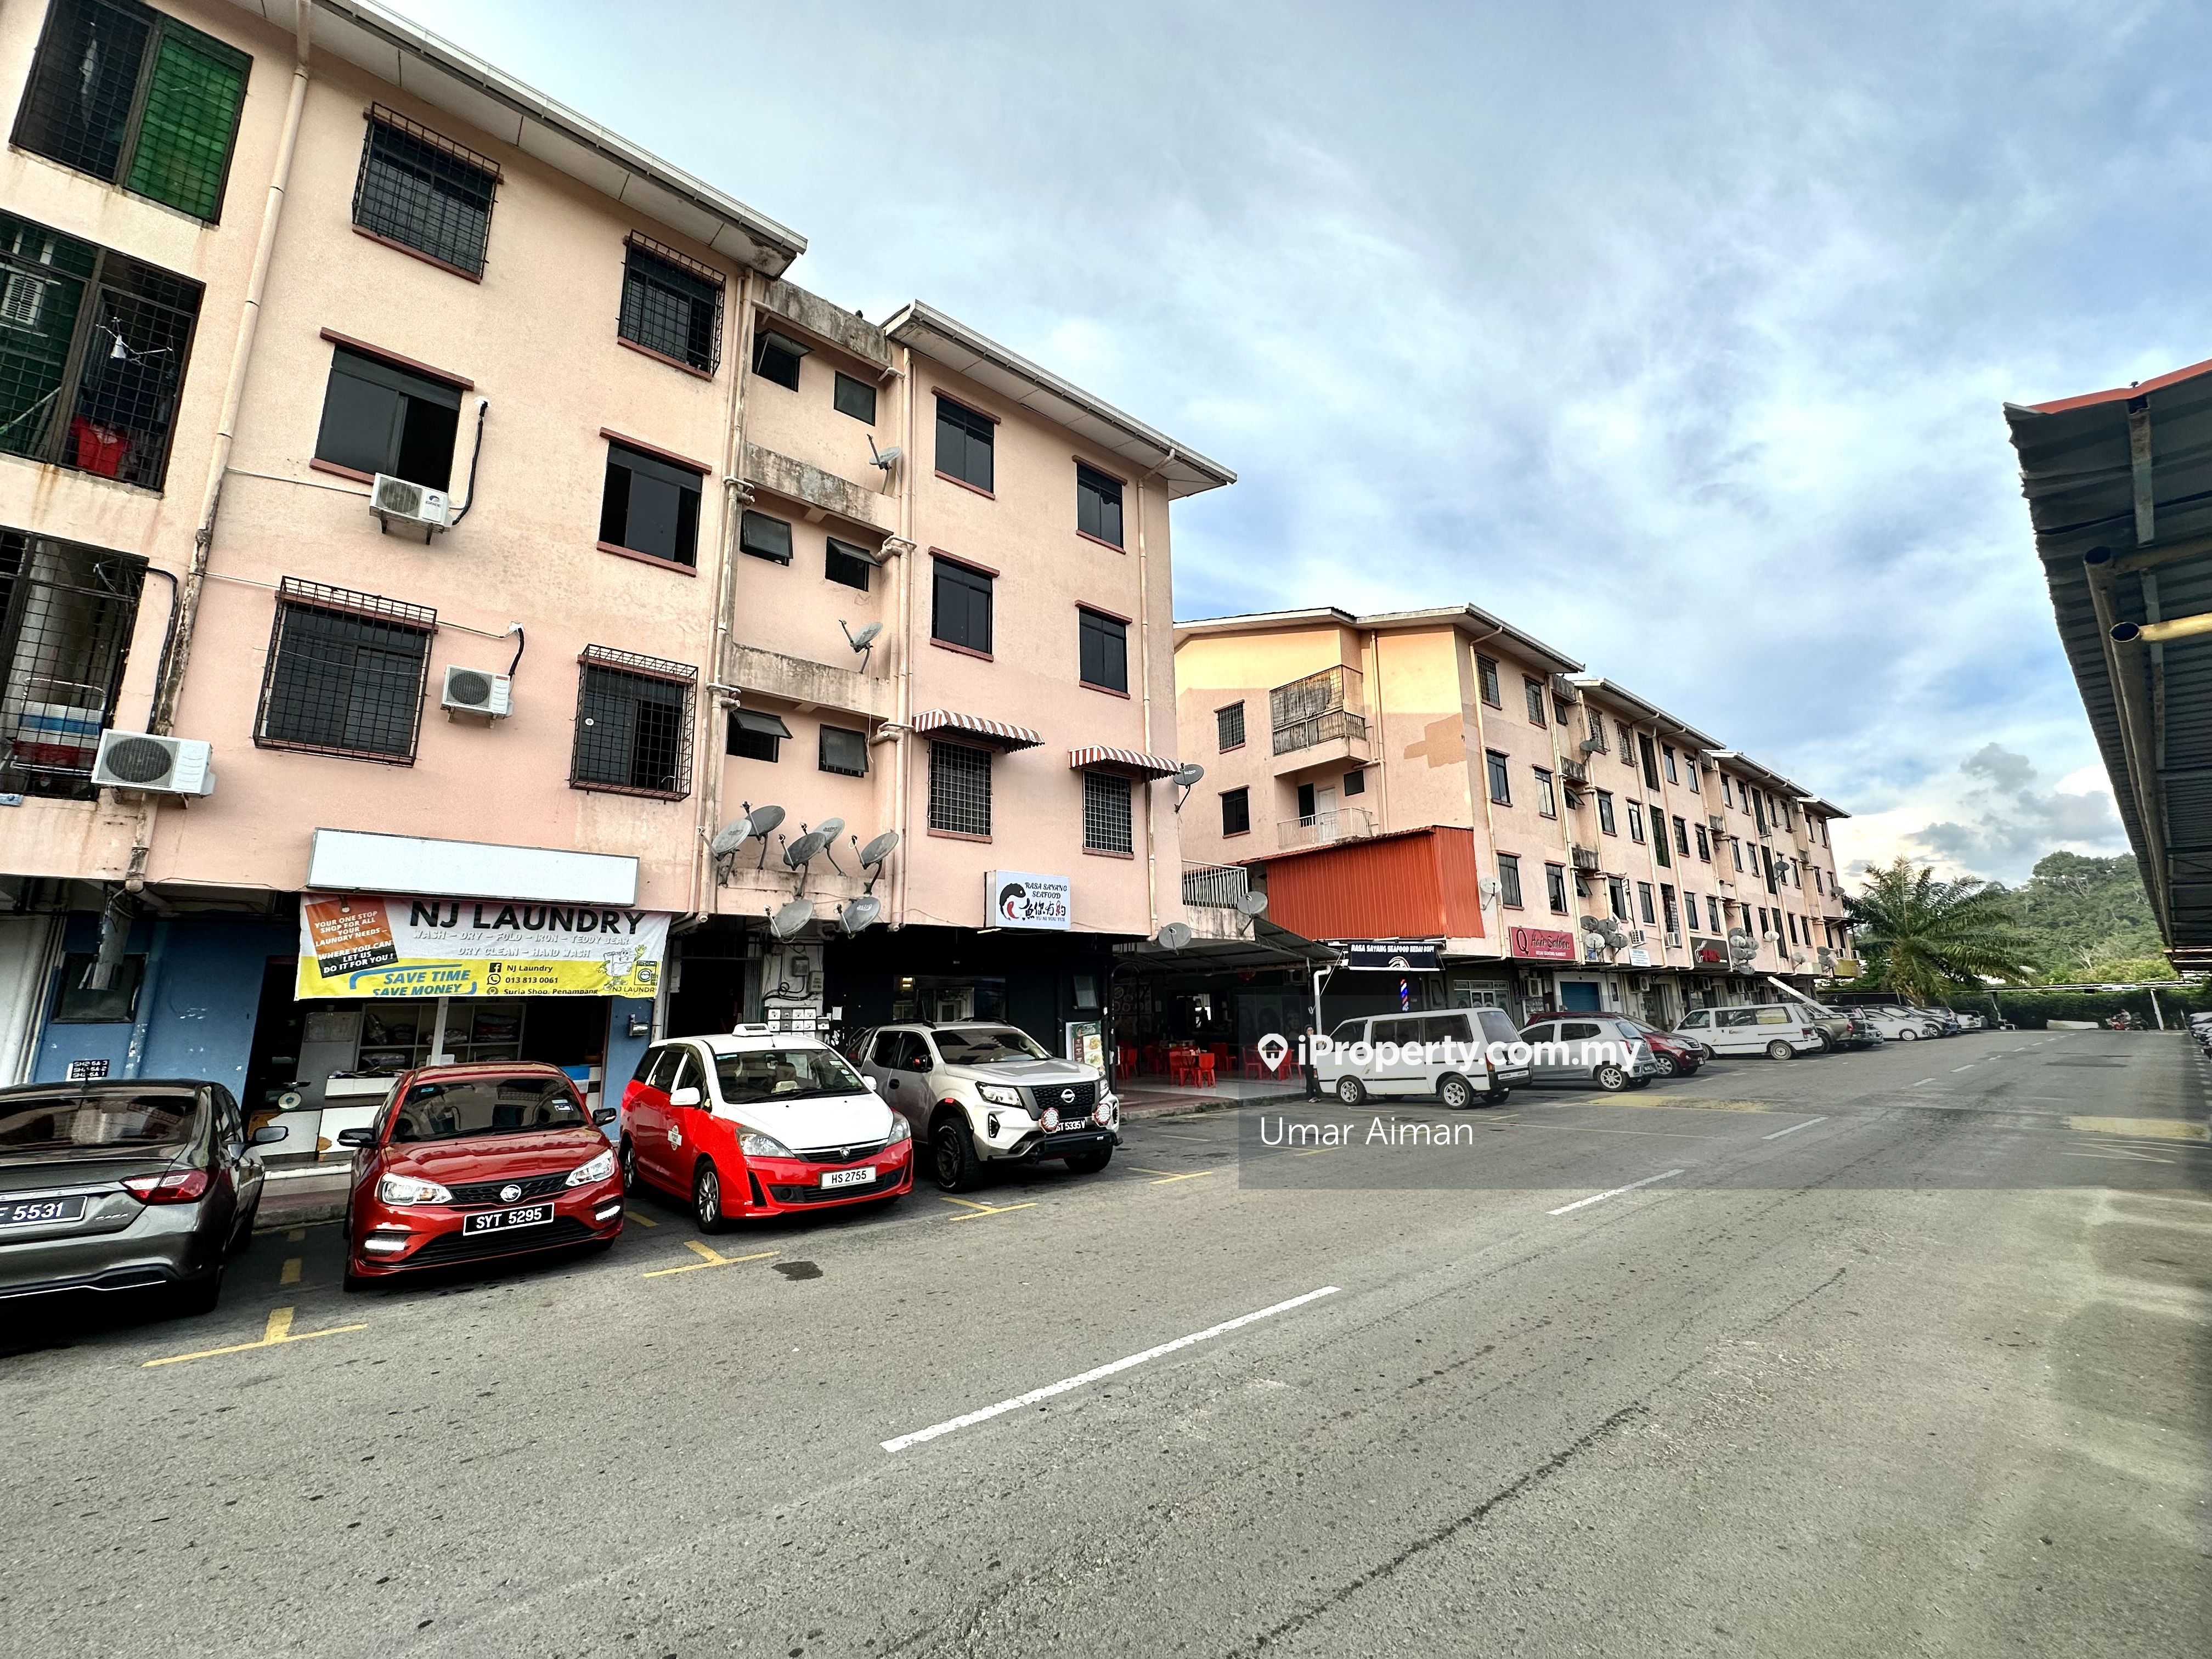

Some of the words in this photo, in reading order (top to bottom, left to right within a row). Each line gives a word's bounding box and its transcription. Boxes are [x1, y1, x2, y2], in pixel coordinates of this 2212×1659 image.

[1024, 882, 1042, 890] RASA
[1042, 883, 1068, 892] SAYANG
[1032, 890, 1061, 899] SEAFOOD
[314, 920, 337, 929] YOUR
[339, 915, 356, 923] ONE
[358, 911, 377, 919] STOP
[410, 901, 460, 928] NJ
[473, 904, 646, 934] LAUNDRY
[320, 924, 342, 933] SHOP
[337, 927, 360, 935] YOUR
[315, 934, 354, 947] LAUNDRY
[355, 928, 381, 938] NEEDS
[413, 930, 447, 940] WASH
[460, 932, 483, 940] DRY
[496, 933, 522, 941] FOLD
[535, 934, 558, 943] IRON
[571, 935, 602, 944] TEDDY
[1516, 929, 1530, 956] Q
[1531, 935, 1546, 947] Hair
[1547, 935, 1571, 950] Saloon
[318, 949, 351, 960] WHERE
[352, 945, 371, 953] YOU
[373, 940, 393, 949] CAN
[484, 947, 519, 956] CLEAN
[531, 948, 560, 957] HAND
[562, 949, 591, 957] WASH
[324, 965, 337, 974] DO
[349, 959, 368, 968] FOR
[370, 954, 388, 963] YOU
[343, 954, 360, 962] LET
[383, 972, 427, 985] SAVE
[432, 969, 471, 982] TIME
[373, 986, 408, 996] SAVE
[410, 984, 462, 996] MONEY
[832, 1174, 843, 1184] HS
[845, 1170, 867, 1182] 2755
[12, 1201, 64, 1221] 5531
[476, 1214, 503, 1229] SYT
[508, 1207, 542, 1224] 5295
